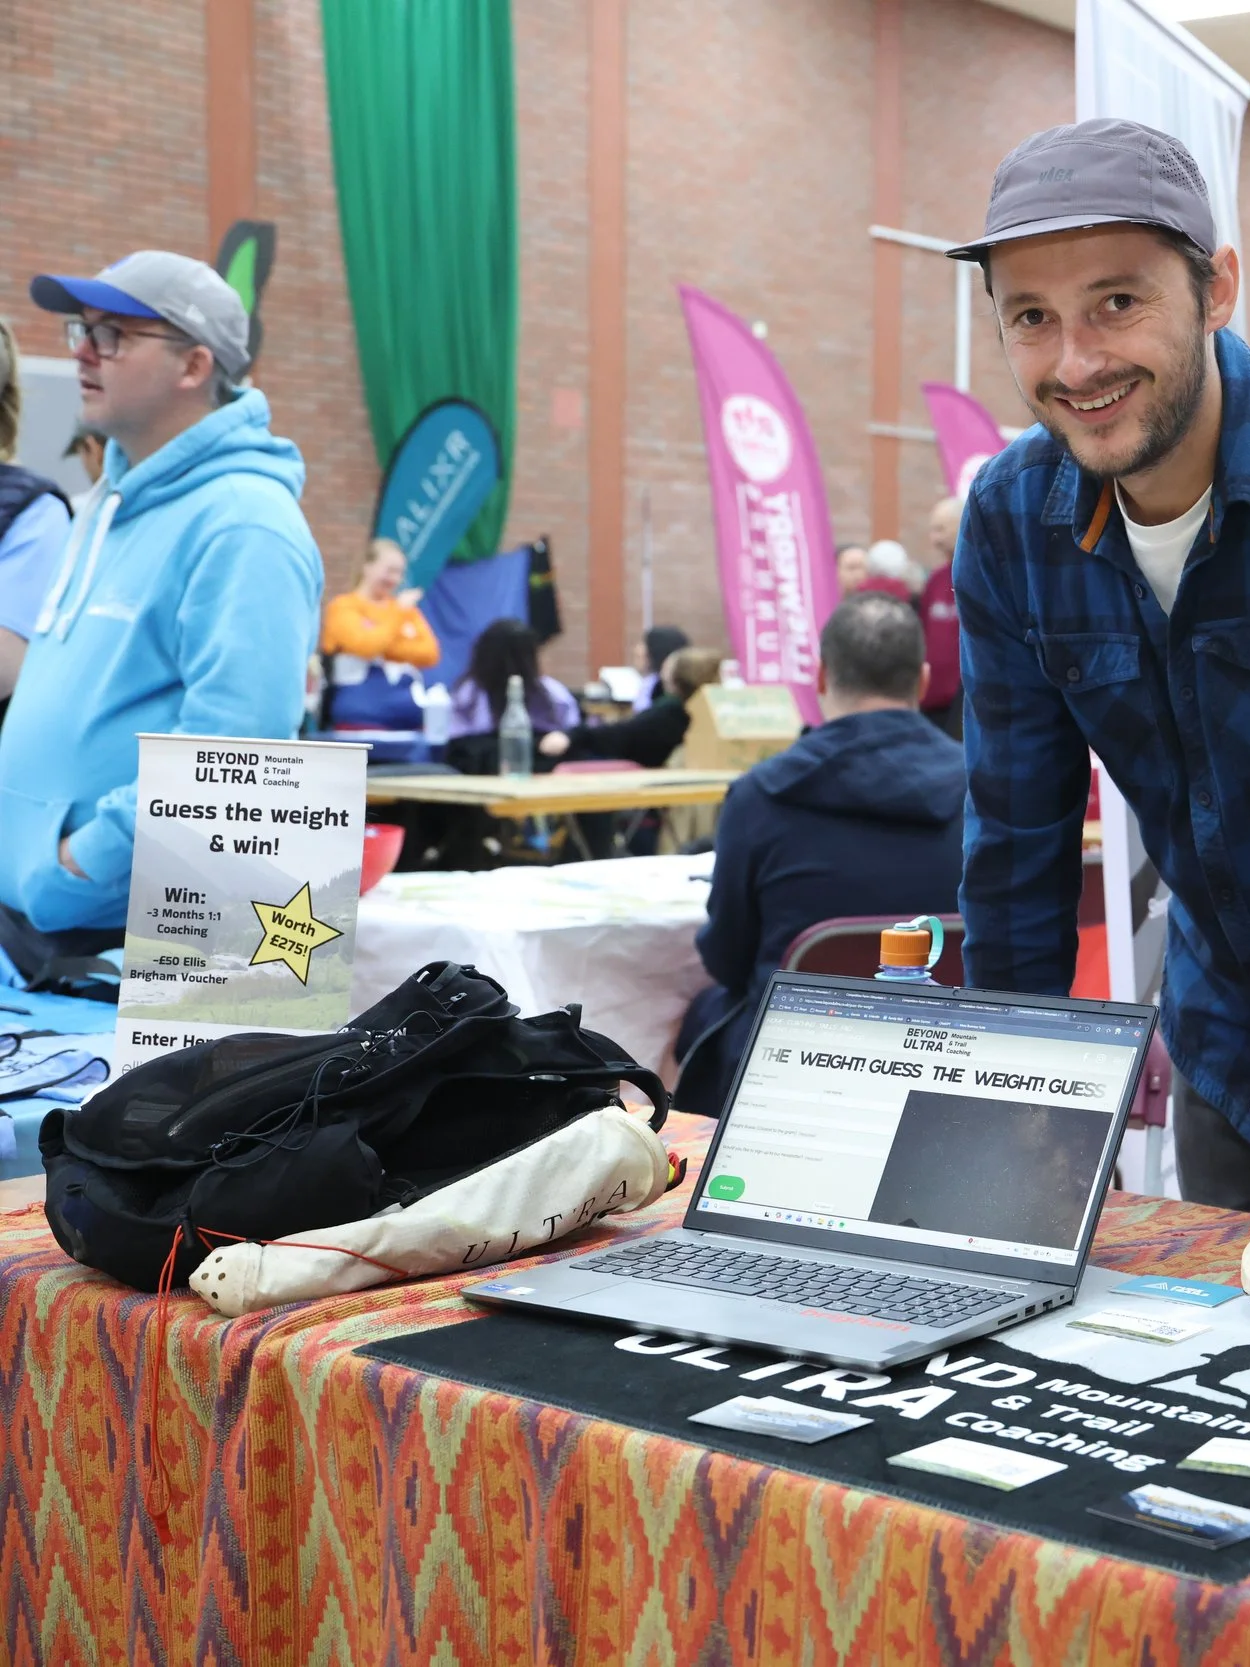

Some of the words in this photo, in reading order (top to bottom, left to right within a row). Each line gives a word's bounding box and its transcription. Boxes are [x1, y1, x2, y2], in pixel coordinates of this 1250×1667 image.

[196, 751, 260, 766] BEYOND
[264, 755, 304, 764] Mountain
[195, 768, 257, 785] ULTRA
[264, 767, 270, 775] &
[272, 767, 291, 776] Trail
[263, 778, 300, 789] Coaching
[149, 799, 217, 820] Guess
[225, 802, 263, 823] the
[271, 805, 349, 830] weight
[209, 835, 225, 853] &
[233, 837, 280, 856] win!
[164, 887, 206, 905] Win:
[147, 908, 160, 919] -3
[162, 909, 205, 921] Months
[208, 911, 221, 921] 1:1
[157, 924, 208, 937] Coaching
[271, 911, 316, 937] Worth
[269, 934, 309, 957] £275!
[152, 956, 180, 966] -£50
[183, 956, 207, 968] Ellis
[130, 969, 177, 983] Brigham
[181, 972, 228, 985] Voucher
[132, 1031, 178, 1047] Enter
[907, 1028, 948, 1040] BEYOND
[951, 1033, 977, 1041] Mountain
[903, 1039, 943, 1052] ULTRA
[946, 1048, 971, 1056] Coaching
[761, 1047, 792, 1063] THE
[800, 1051, 867, 1072] WEIGHT!
[869, 1059, 924, 1078] GUESS
[933, 1066, 965, 1083] THE
[975, 1070, 1045, 1092] WEIGHT!
[1049, 1078, 1107, 1099] GUESS
[991, 1393, 1033, 1411] &
[1046, 1403, 1154, 1439] Trail
[943, 1410, 1166, 1473] Coaching
